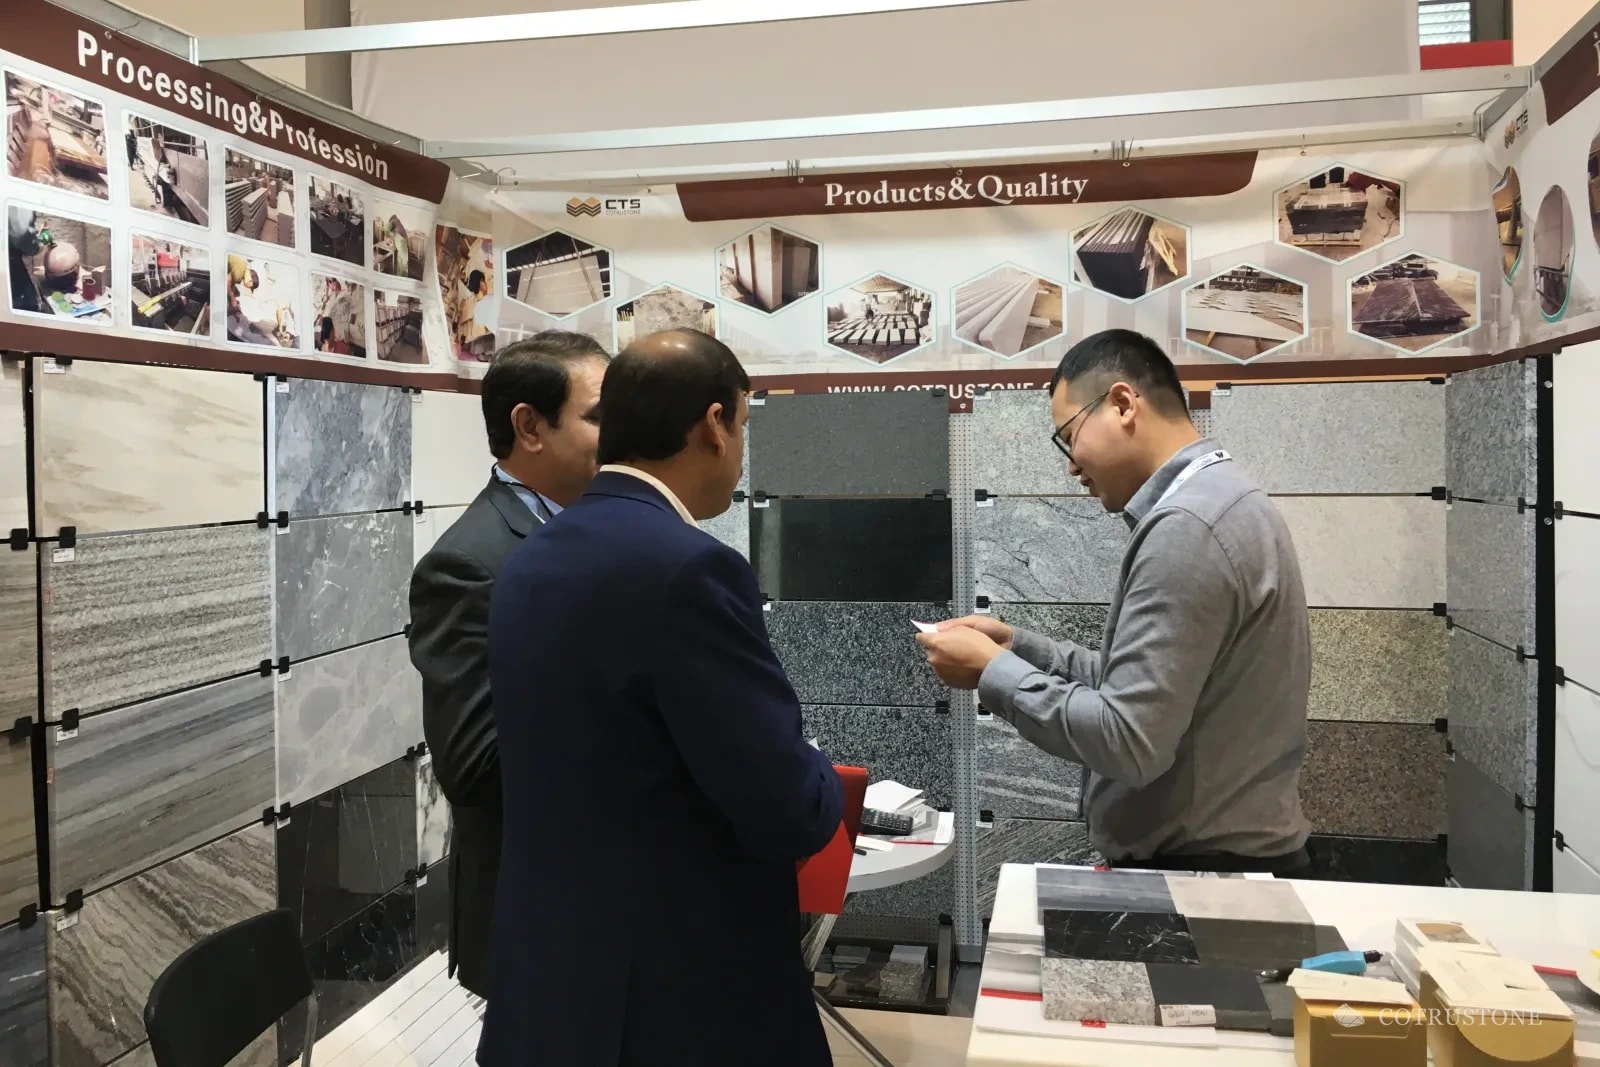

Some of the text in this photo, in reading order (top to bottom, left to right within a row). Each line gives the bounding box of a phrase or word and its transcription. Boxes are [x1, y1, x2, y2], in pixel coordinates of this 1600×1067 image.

[77, 29, 389, 181] Processing&Profession
[605, 199, 641, 210] CTS
[824, 172, 1089, 206] Products&Quality
